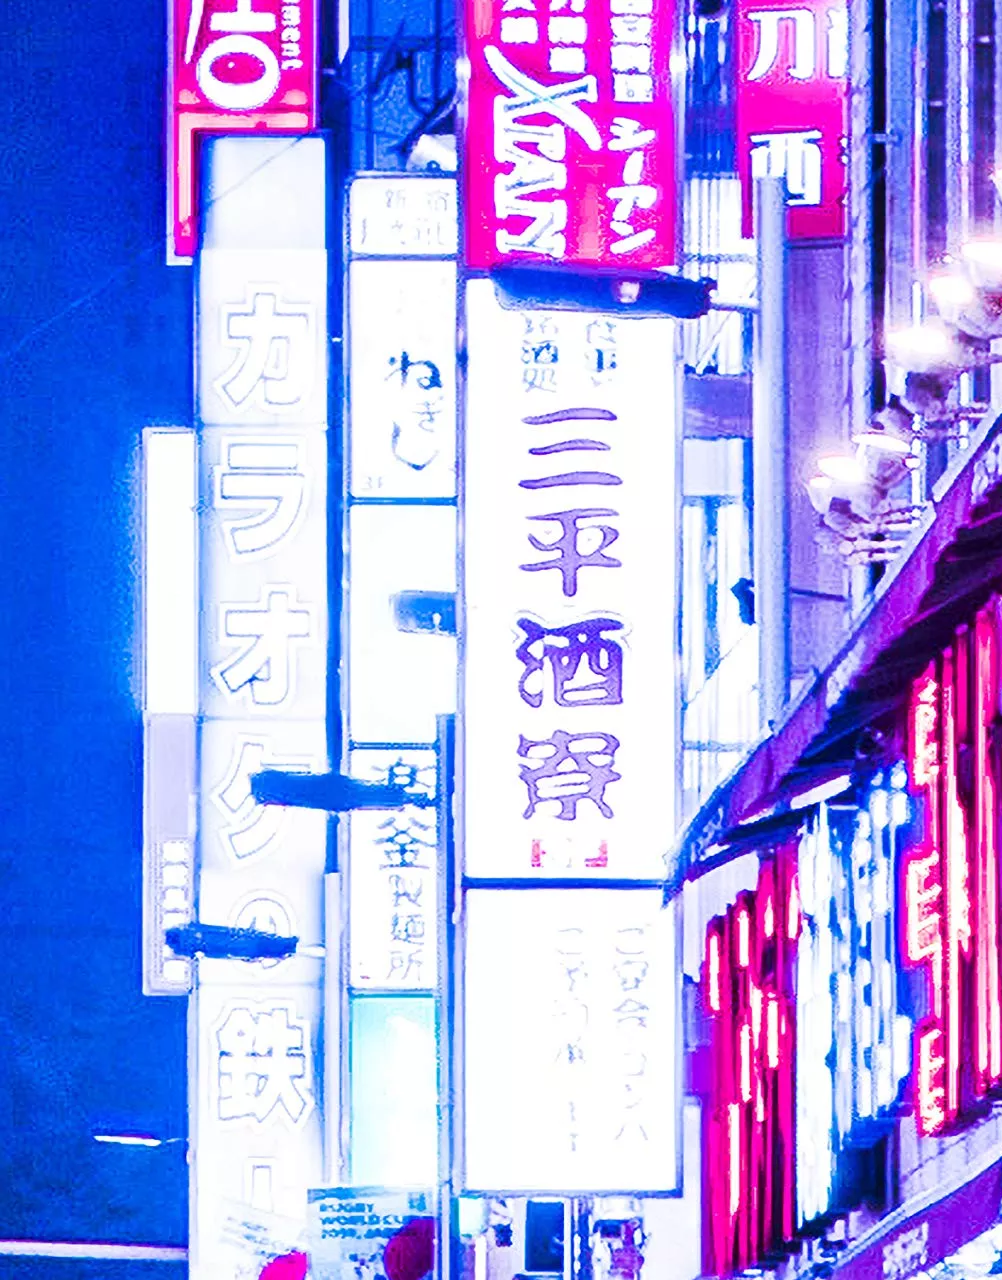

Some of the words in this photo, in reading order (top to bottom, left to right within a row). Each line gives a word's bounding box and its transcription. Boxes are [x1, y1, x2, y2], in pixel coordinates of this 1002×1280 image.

[281, 0, 304, 70] ment
[383, 348, 444, 472] ねぎし
[211, 284, 313, 1212] カラオケの鉄
